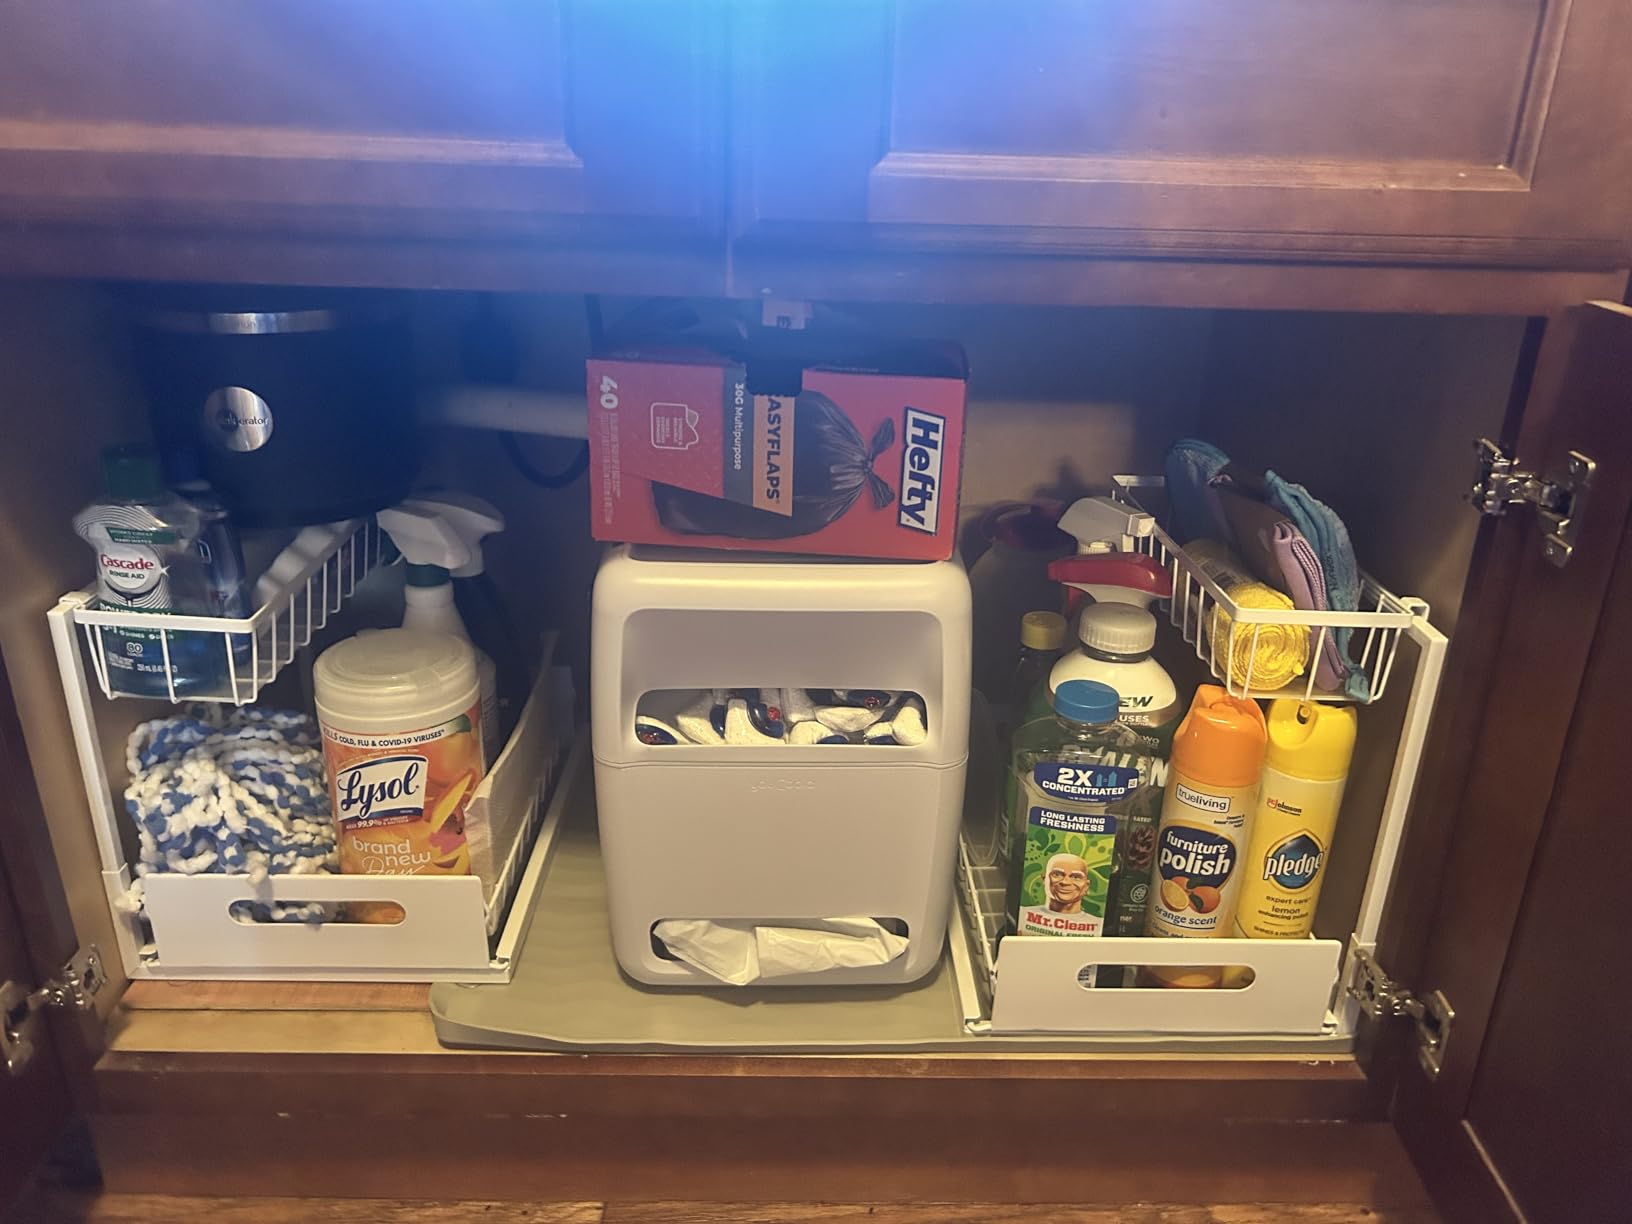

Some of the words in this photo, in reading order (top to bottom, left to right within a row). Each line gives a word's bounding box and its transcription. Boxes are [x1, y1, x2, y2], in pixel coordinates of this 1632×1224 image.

[600, 376, 619, 409] 40
[734, 383, 745, 405] 30G
[734, 407, 745, 470] Multipurpose
[766, 395, 783, 500] ASYFLAPS
[900, 416, 941, 527] Hefty
[101, 554, 154, 570] Cascade
[109, 570, 130, 579] RINSE
[127, 643, 143, 653] 80
[1119, 696, 1153, 708] EW
[1119, 713, 1150, 723] USES
[323, 727, 339, 741] KILLS
[339, 735, 357, 746] COLD,
[357, 739, 370, 747] FLU
[379, 737, 412, 747] COVID-19
[1057, 767, 1094, 787] 2X
[337, 762, 418, 817] Lysol
[1042, 780, 1125, 796] CONCENTRATED
[1178, 787, 1227, 810] trueliving
[357, 819, 382, 829] 99.9%
[1040, 810, 1065, 821] LONG
[1066, 815, 1106, 825] LASTING
[1040, 817, 1105, 832] FRESHNESS
[352, 837, 410, 854] brand
[1166, 831, 1229, 854] furniture
[385, 851, 431, 868] new
[1160, 847, 1231, 875] polish
[1264, 852, 1325, 880] pledge
[1154, 904, 1188, 925] orange
[1188, 915, 1217, 925] scent
[1271, 904, 1301, 915] lemon
[1024, 925, 1064, 937] ORIGINAL
